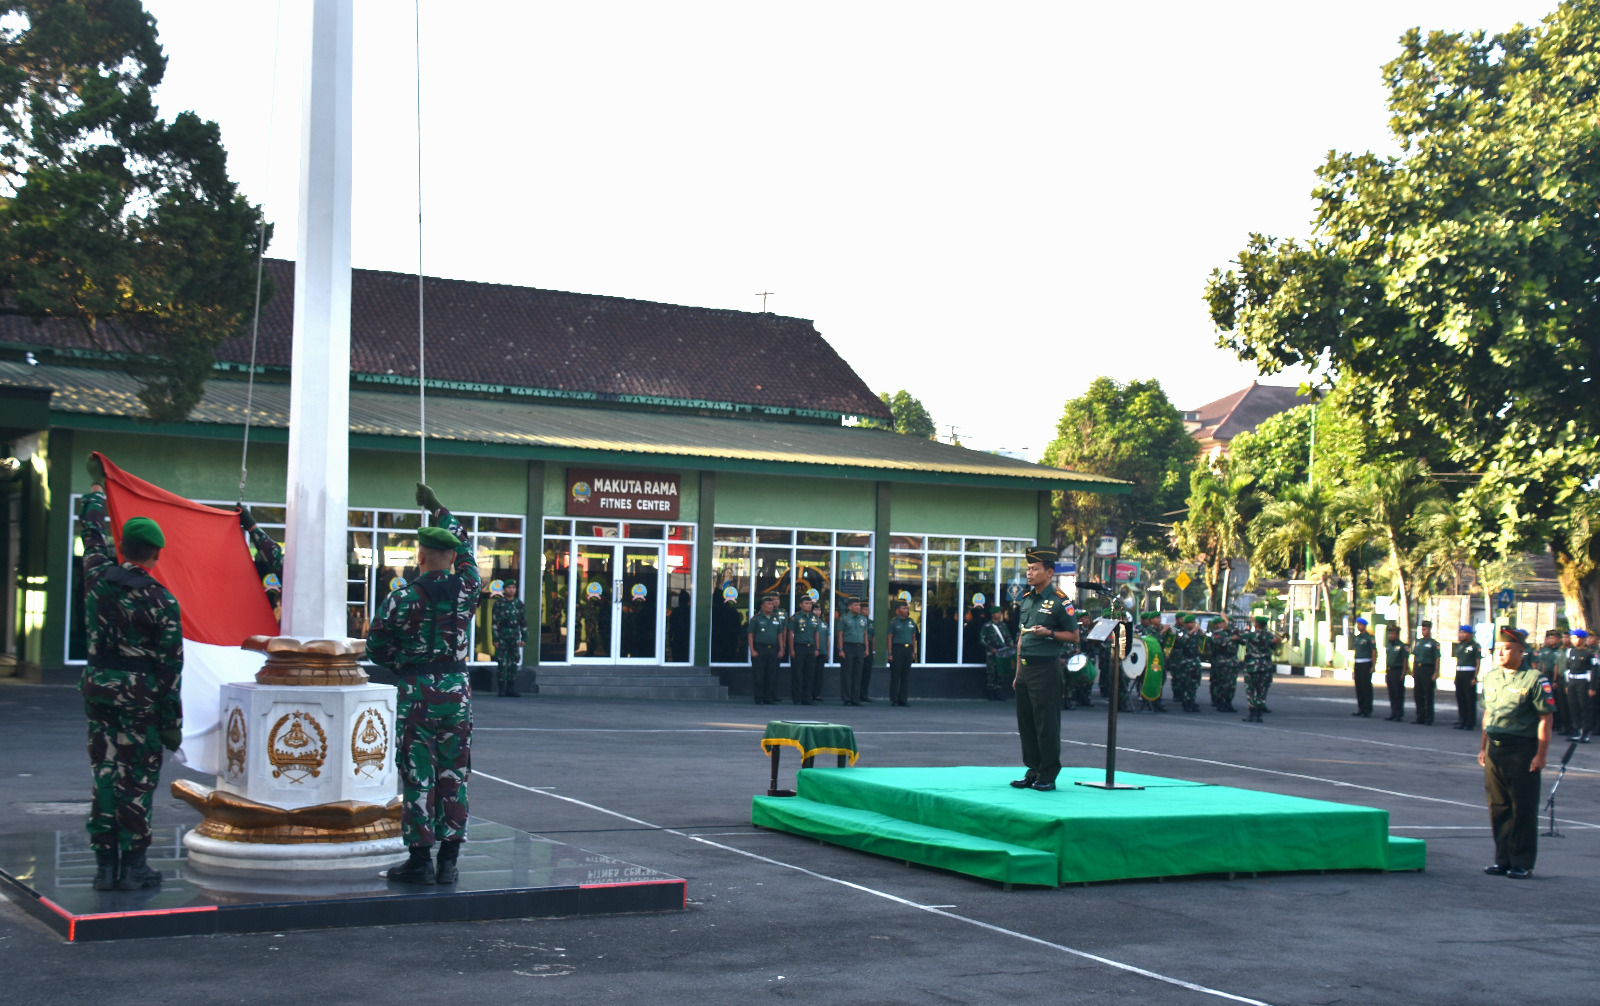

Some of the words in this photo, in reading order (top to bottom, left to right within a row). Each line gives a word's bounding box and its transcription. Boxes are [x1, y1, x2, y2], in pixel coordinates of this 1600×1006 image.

[594, 478, 642, 494] MAKUTA
[644, 480, 678, 496] RAMA
[600, 497, 632, 510] FITNES
[636, 499, 670, 511] CENTER
